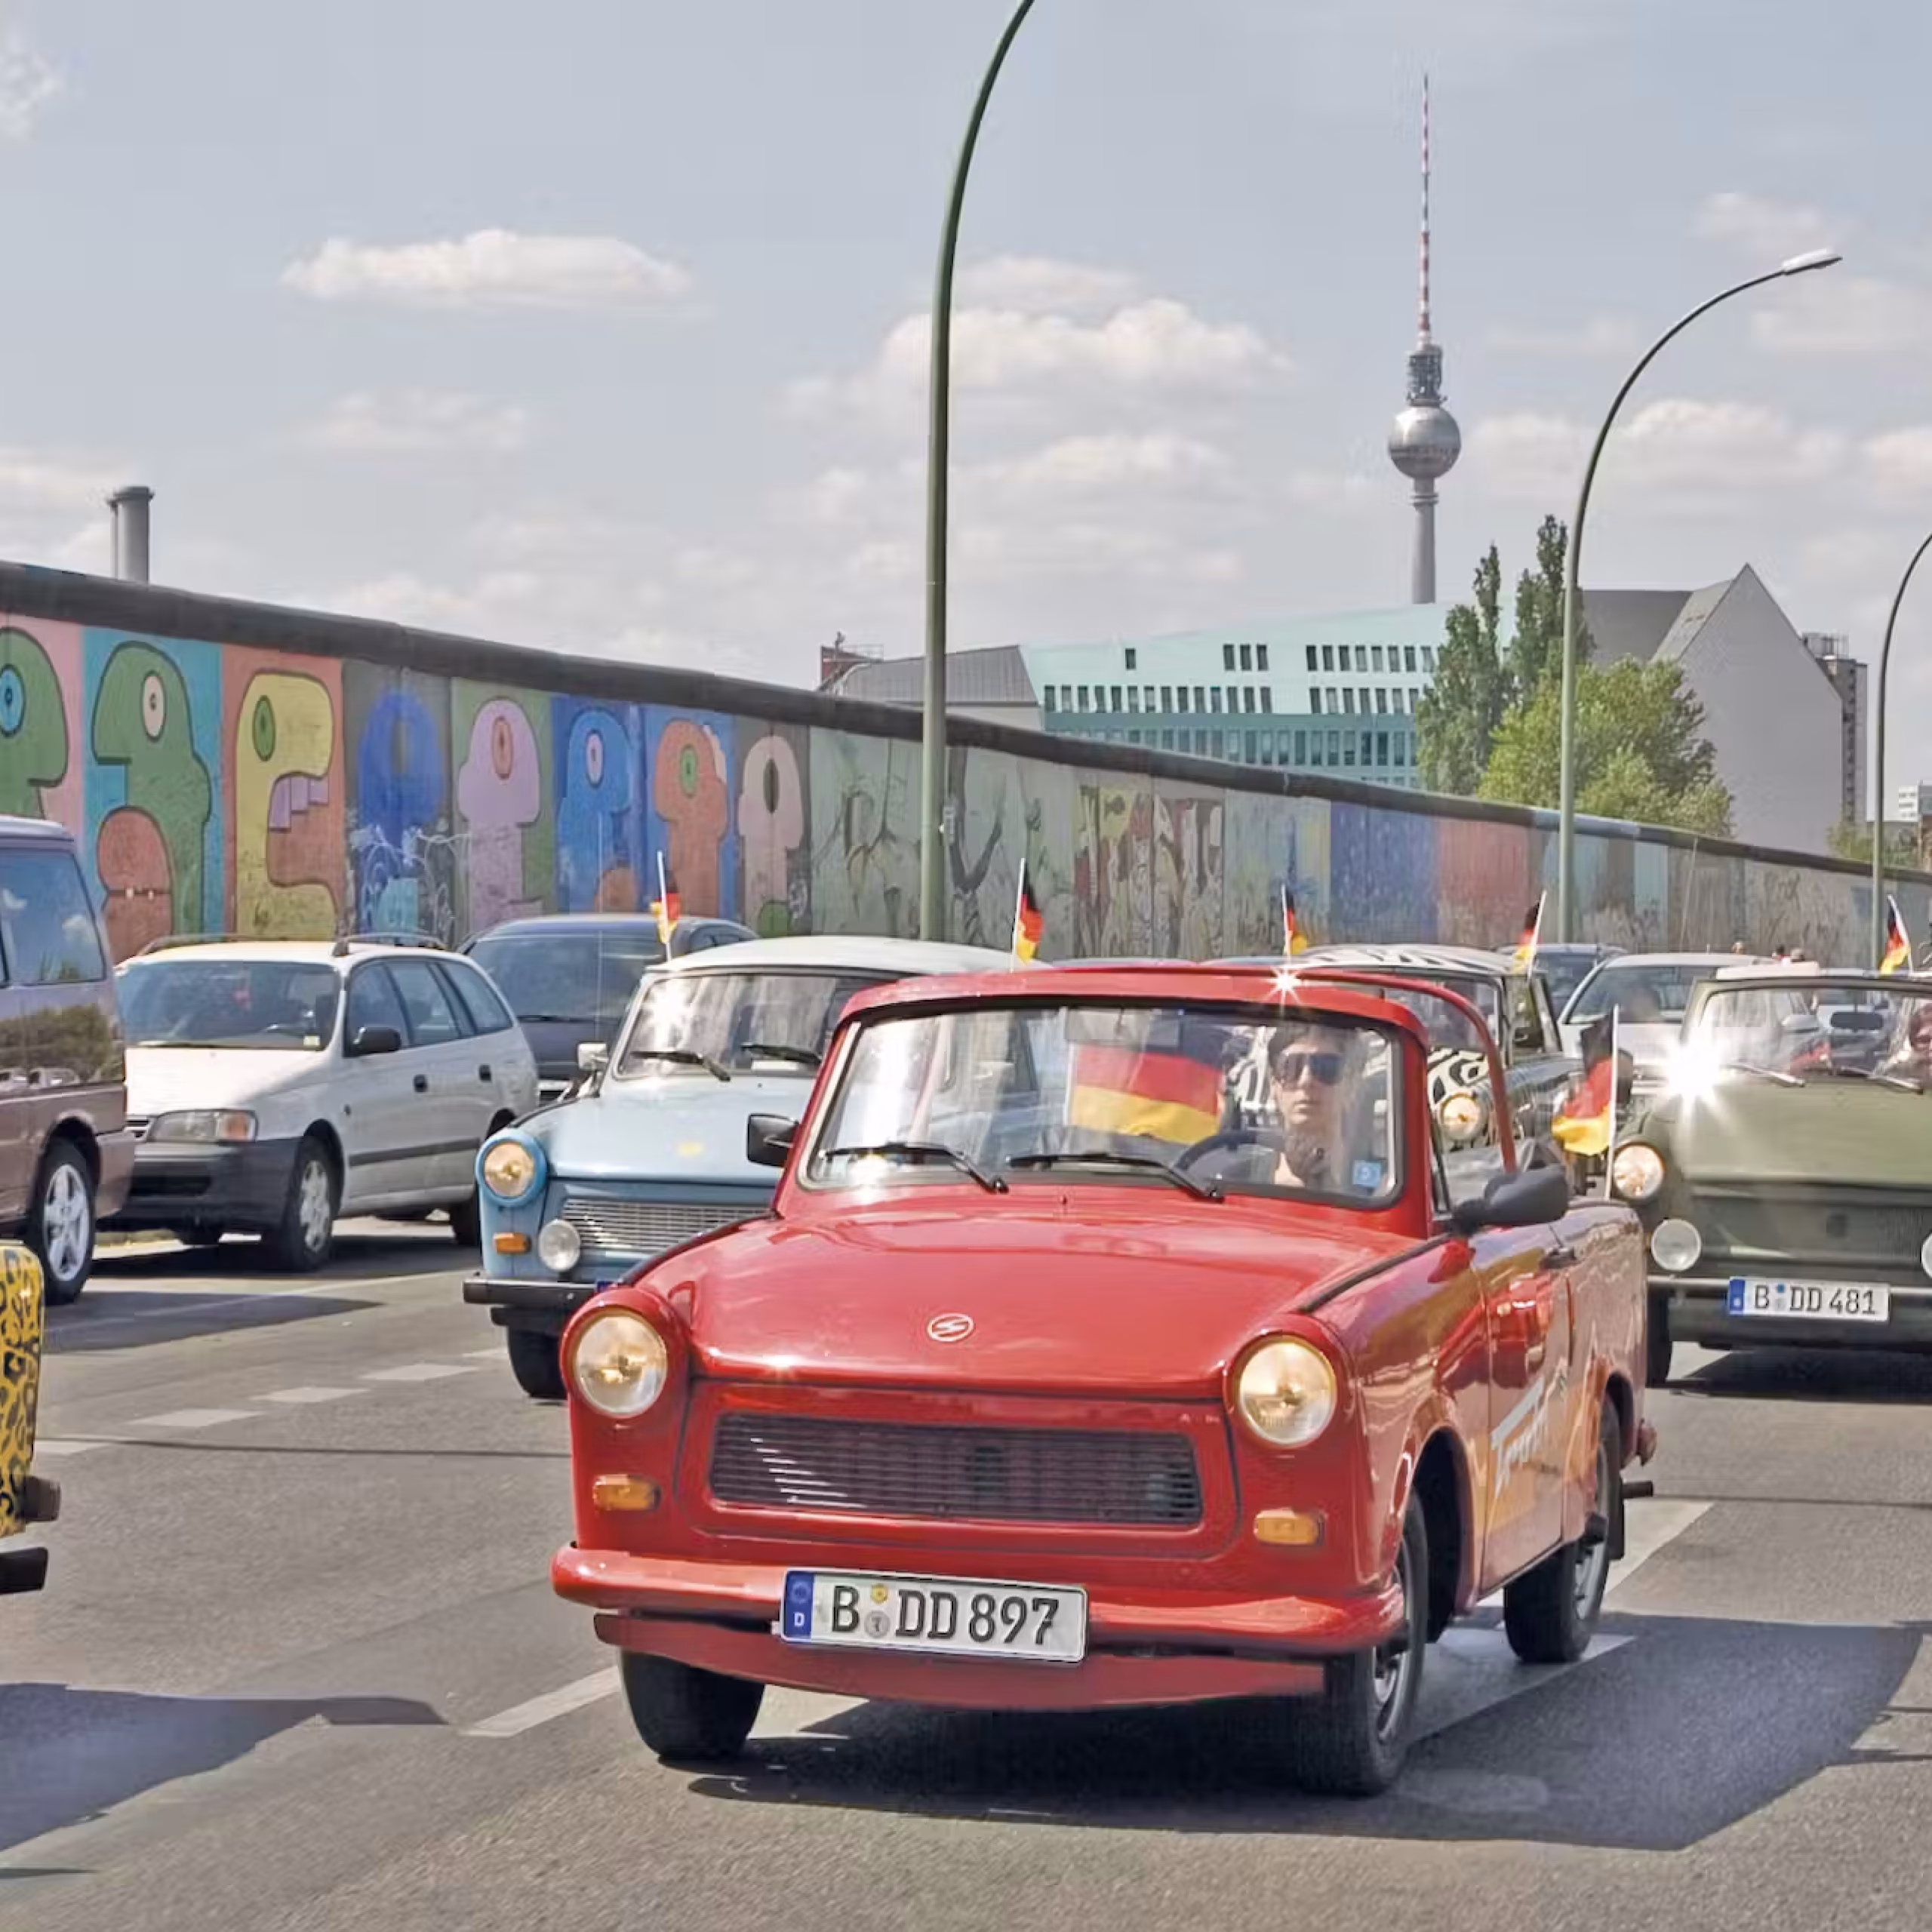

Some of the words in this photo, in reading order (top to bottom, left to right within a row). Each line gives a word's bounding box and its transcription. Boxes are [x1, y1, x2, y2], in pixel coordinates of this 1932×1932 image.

[1755, 1284, 1770, 1309] B
[1789, 1286, 1823, 1312] DD
[1829, 1287, 1876, 1315] 481
[794, 1612, 805, 1626] D
[831, 1586, 860, 1632] B
[895, 1589, 958, 1640] DD
[968, 1592, 1060, 1645] 897
